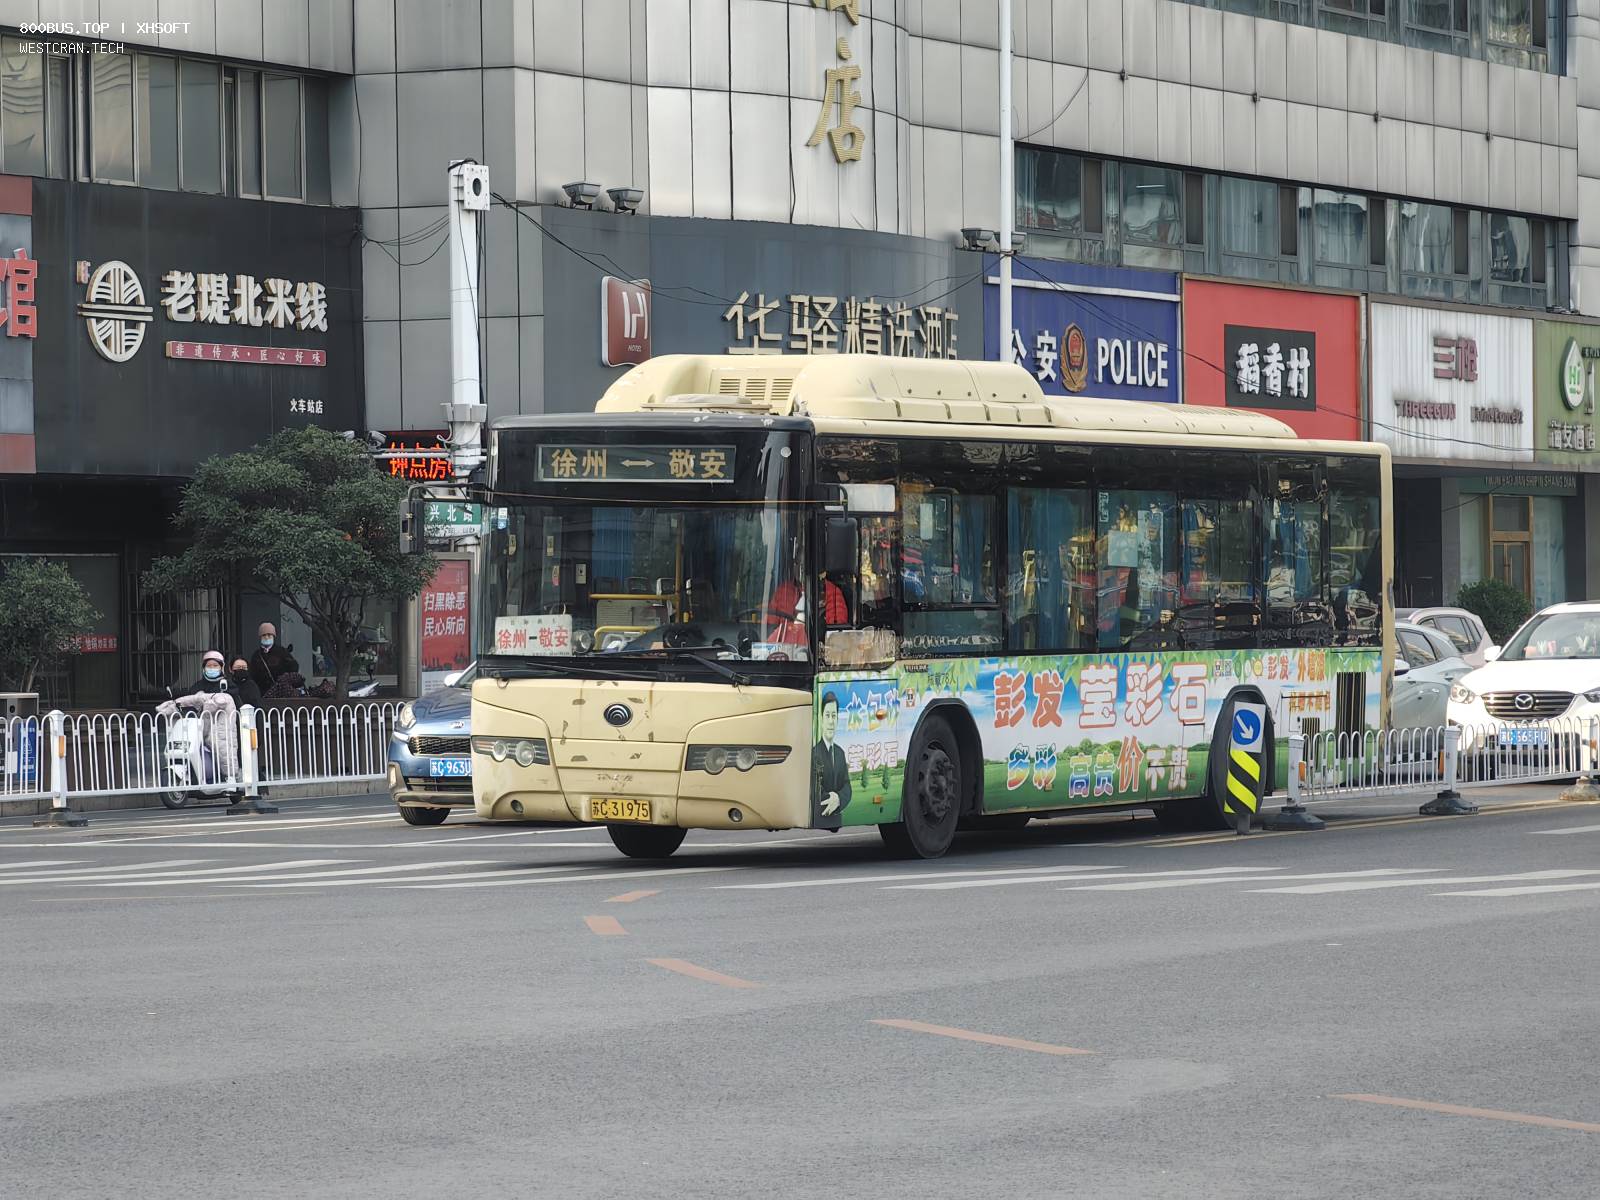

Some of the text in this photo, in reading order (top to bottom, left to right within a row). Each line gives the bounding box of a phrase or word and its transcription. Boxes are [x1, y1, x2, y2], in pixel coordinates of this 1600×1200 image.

[806, 0, 865, 163] 店
[160, 270, 328, 332] 老堤北米线
[1097, 338, 1169, 387] POLICE
[1236, 342, 1311, 398] 稻香村
[289, 398, 324, 414] 火车站店
[550, 448, 727, 479] 徐州 敬安
[424, 591, 466, 611] 扫黑除恶
[424, 616, 466, 636] 民心所向
[994, 670, 1065, 729] 彭发
